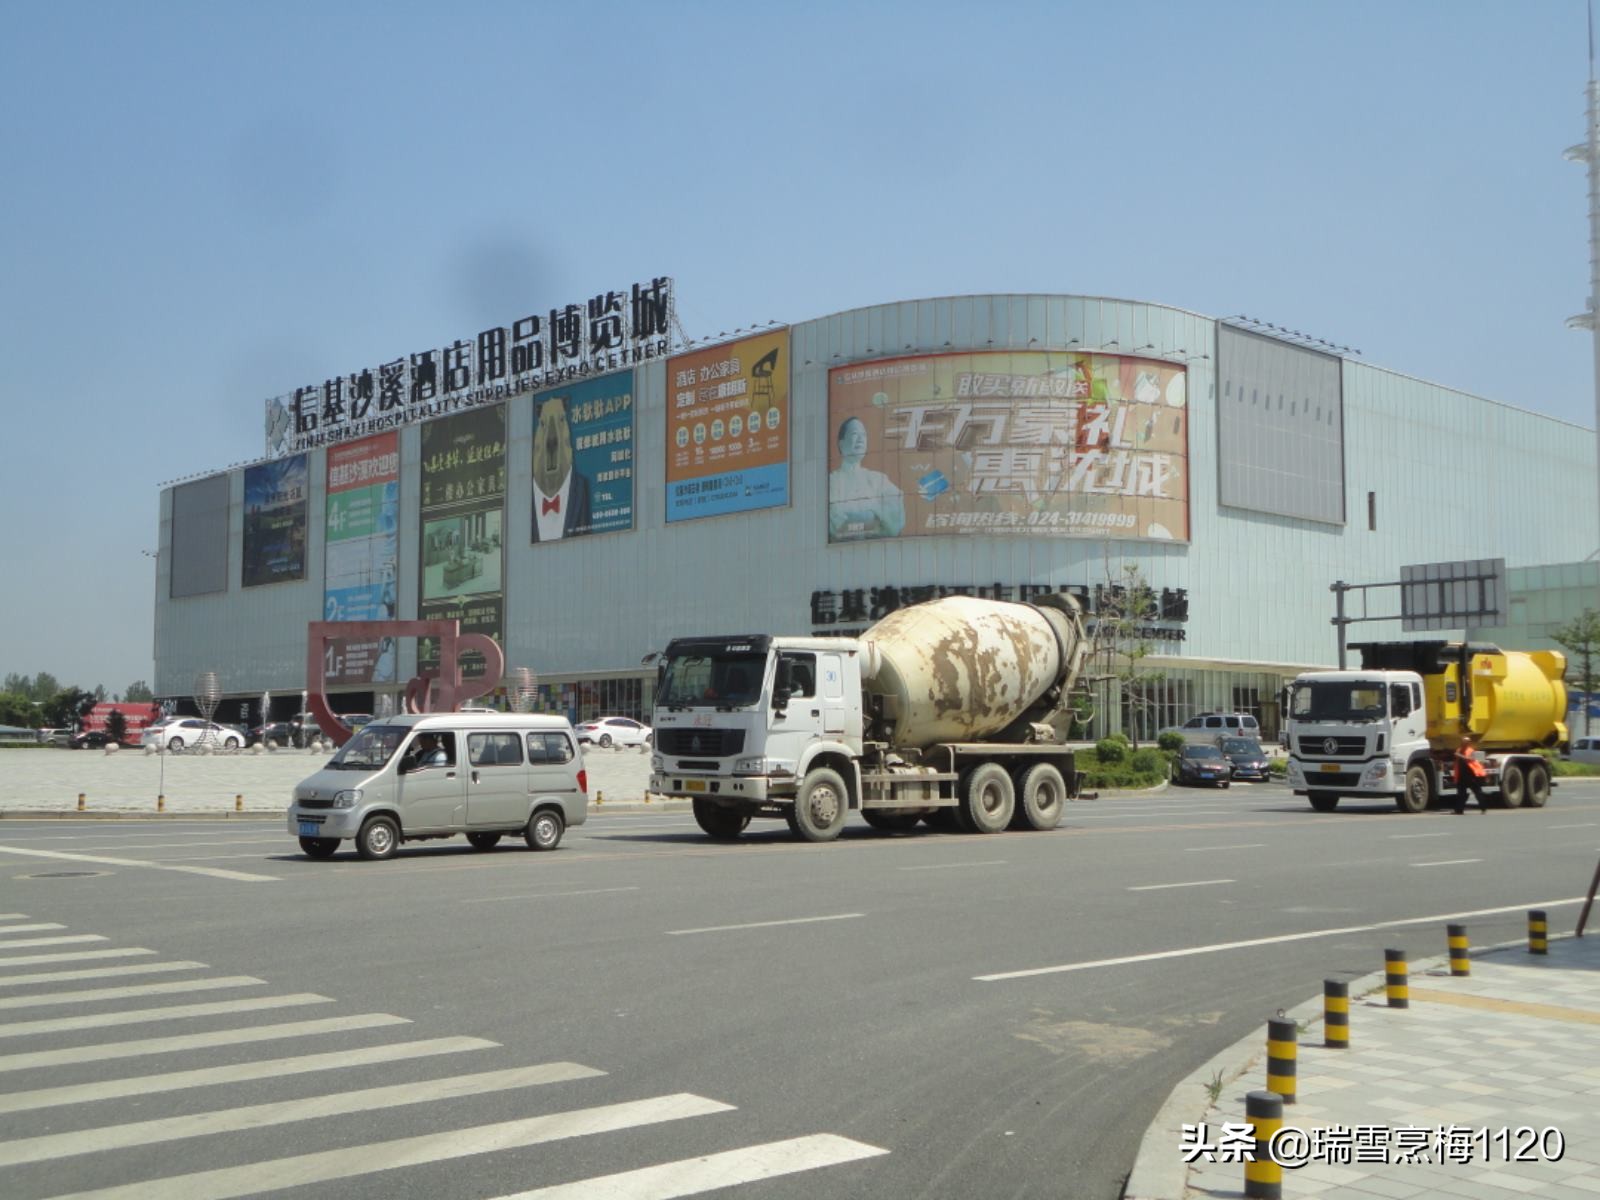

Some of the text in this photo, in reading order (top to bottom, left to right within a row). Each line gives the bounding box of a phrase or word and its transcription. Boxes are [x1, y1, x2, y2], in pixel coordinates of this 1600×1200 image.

[292, 276, 670, 434] 信基沙溪酒店用品博览城
[545, 361, 589, 386] EXPO
[676, 357, 741, 388] 酒店 办公家具
[885, 402, 1136, 451] 千万豪礼
[966, 447, 1172, 502] 惠沈城
[325, 646, 343, 677] 1F
